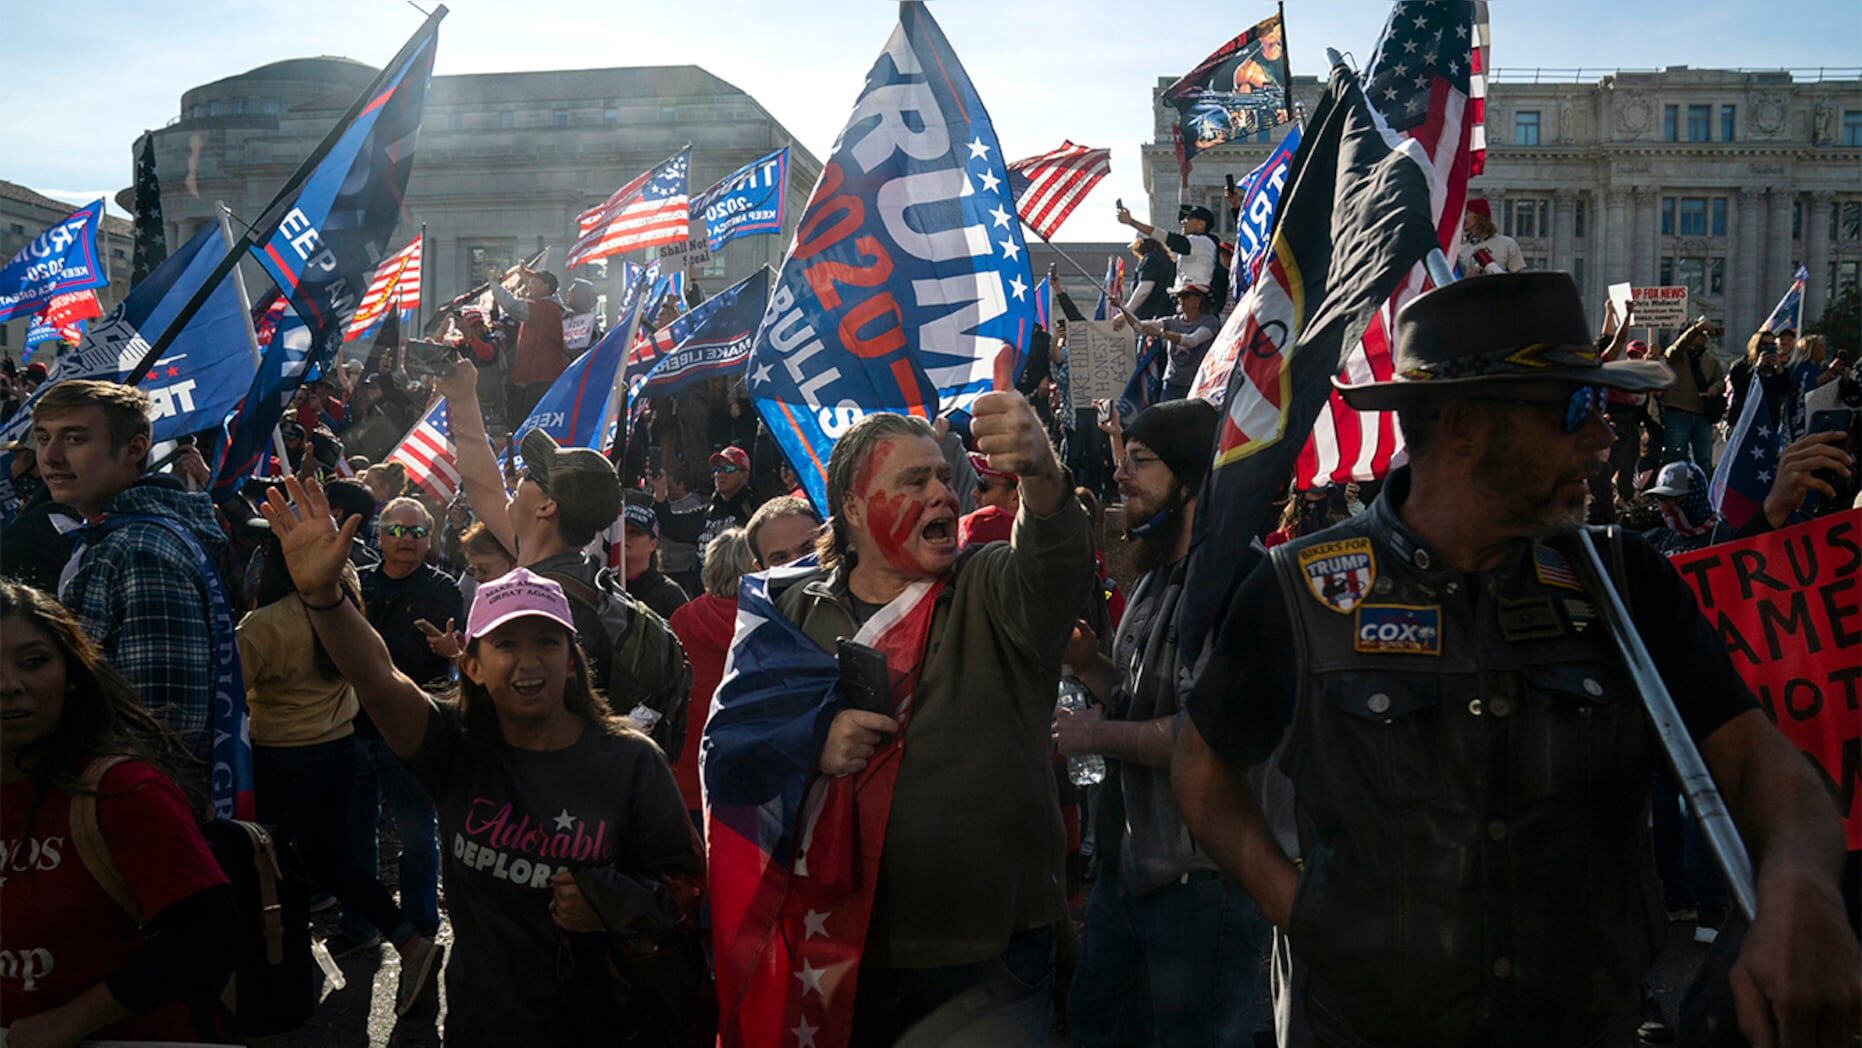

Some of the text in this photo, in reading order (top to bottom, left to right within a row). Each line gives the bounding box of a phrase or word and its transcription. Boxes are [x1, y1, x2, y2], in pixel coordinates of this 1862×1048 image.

[278, 206, 337, 273] EEP
[660, 239, 707, 258] Shall Not
[1643, 287, 1659, 299] FOX
[1661, 287, 1687, 299] NEWS
[1092, 334, 1111, 393] HONEST
[1110, 336, 1128, 384] AGAIN
[1302, 539, 1370, 560] BIKERS FOR
[1306, 553, 1369, 577] TRUMP
[1679, 521, 1862, 609] TRUS
[485, 583, 513, 599] MAKE
[489, 588, 557, 605] GREAT AGAIN
[1360, 623, 1419, 642] COX
